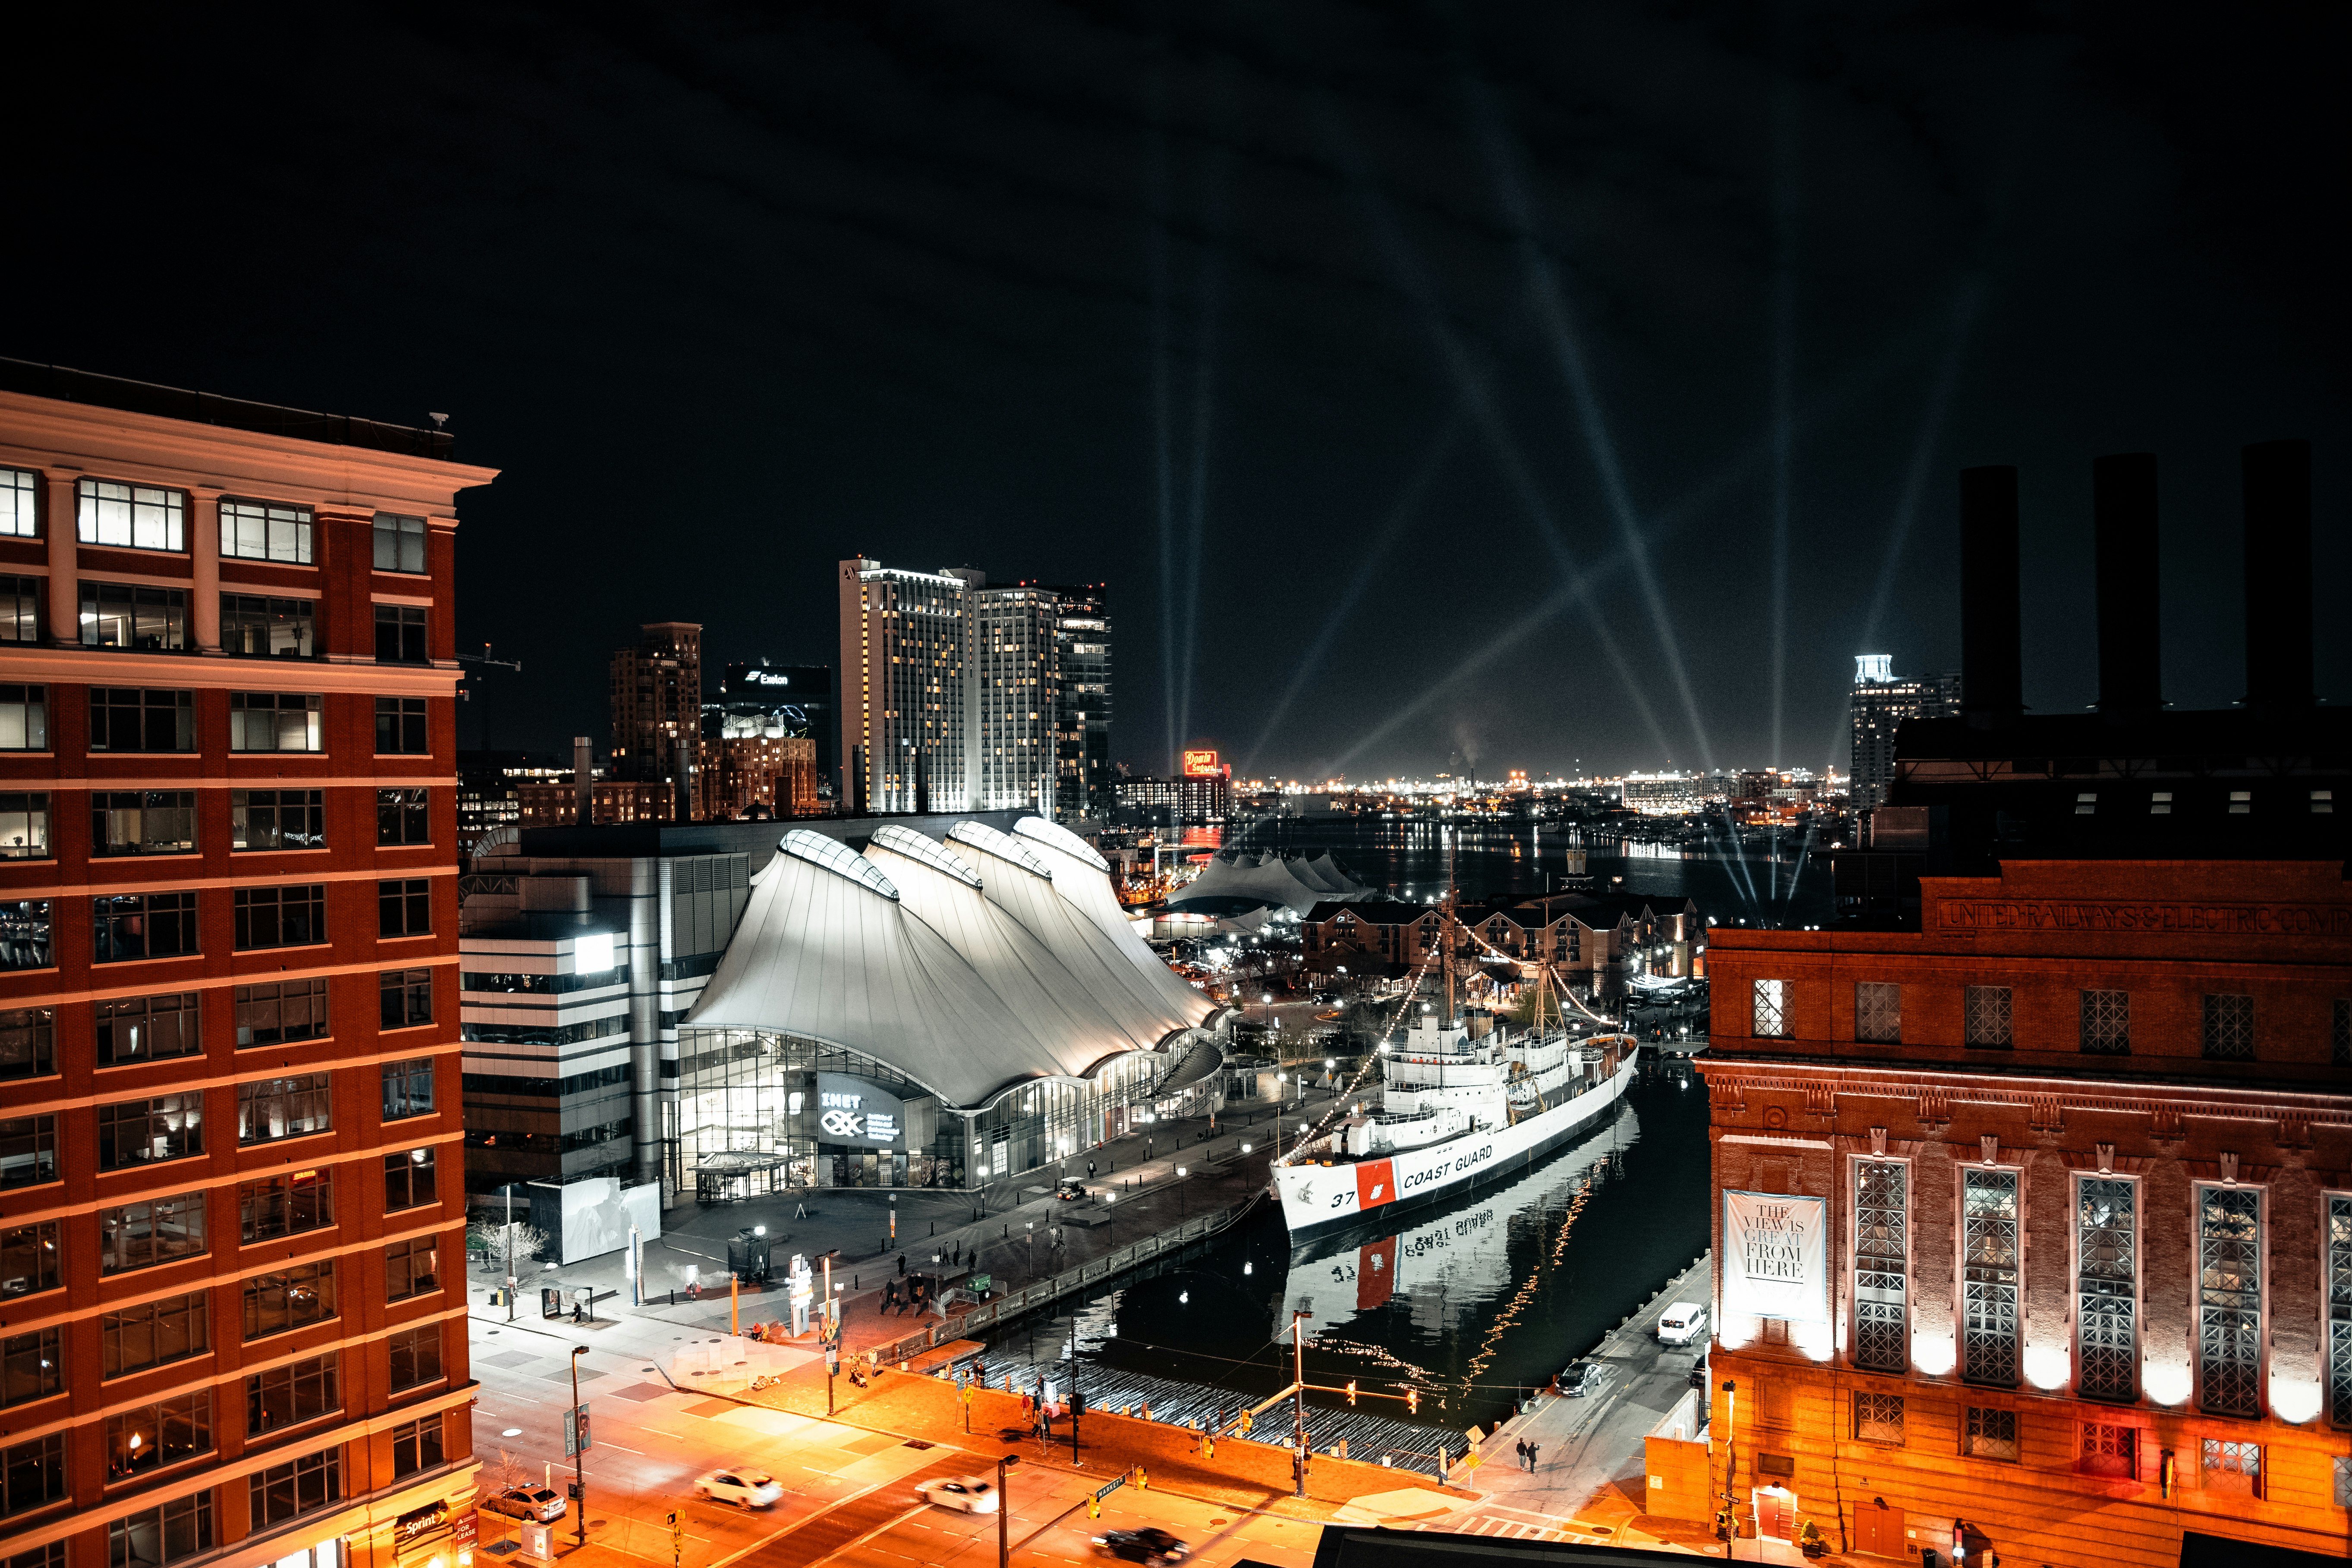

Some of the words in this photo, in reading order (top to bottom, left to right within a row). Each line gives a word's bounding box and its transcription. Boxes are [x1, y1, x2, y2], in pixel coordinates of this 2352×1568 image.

[761, 674, 787, 684] Exelon
[1192, 764, 1214, 773] Sugars
[1950, 903, 2020, 926] UNITED
[2025, 904, 2136, 928] RAILWAYS
[2161, 906, 2270, 931] ELECTRIC
[2278, 908, 2352, 933] COMP
[1404, 1163, 1450, 1188] COAST
[1456, 1144, 1492, 1172] GUARD
[1331, 1191, 1355, 1208] 37
[1756, 1204, 1789, 1219] THE
[1743, 1216, 1786, 1231] VIEW
[1789, 1220, 1804, 1232] IS
[1744, 1228, 1804, 1246] GREAT
[1746, 1242, 1802, 1262] FROM
[1747, 1258, 1803, 1278] HERE
[1099, 1480, 1119, 1497] MARKET
[406, 1514, 436, 1534] Sprint
[457, 1524, 469, 1533] FOR
[457, 1528, 476, 1540] LEASE
